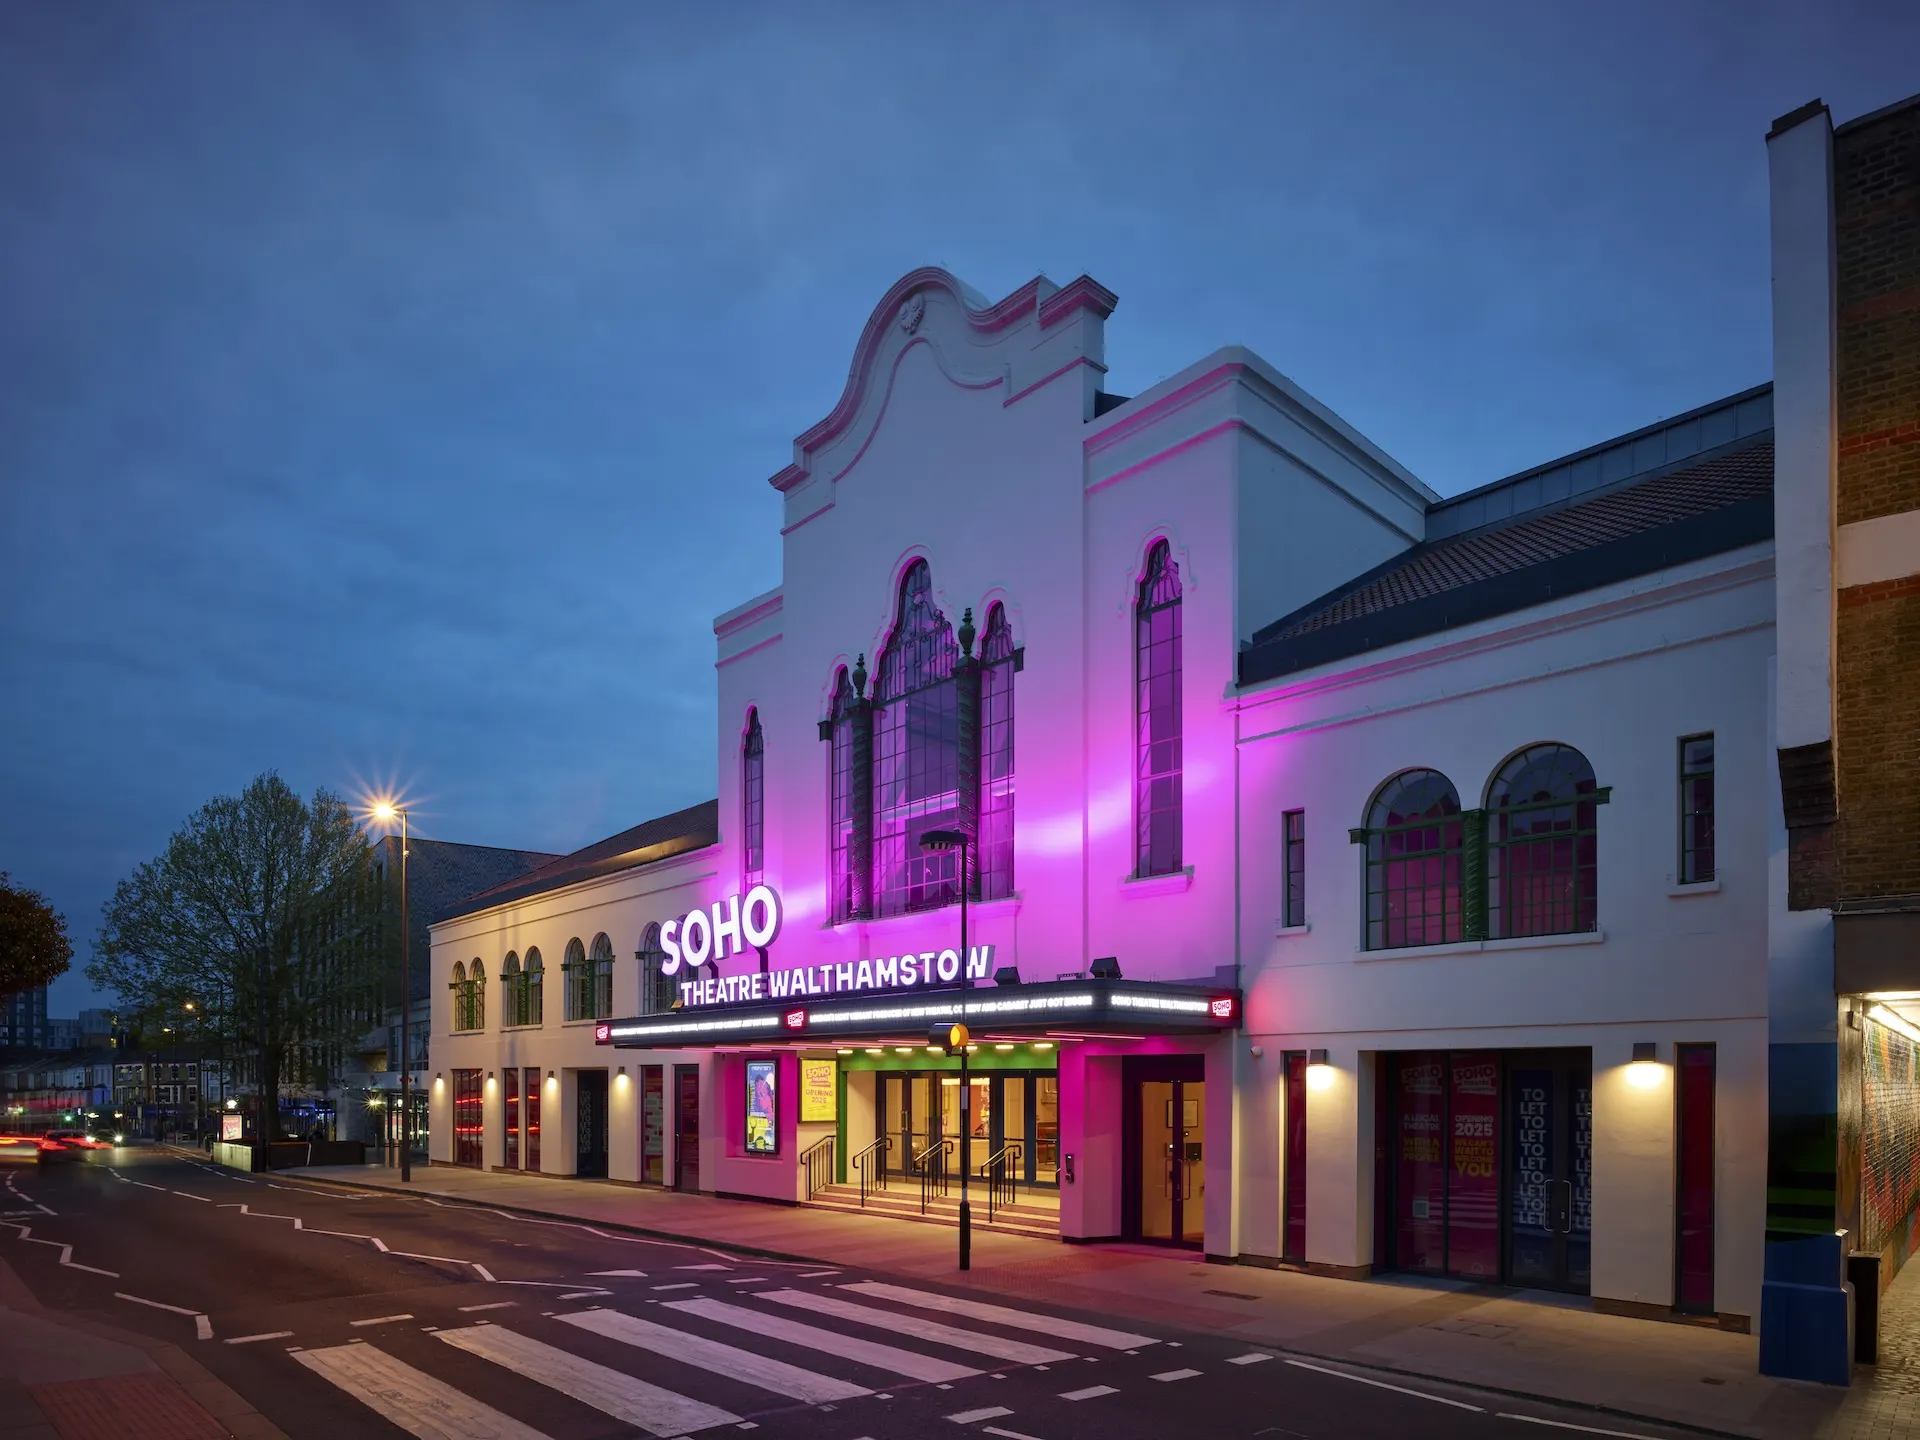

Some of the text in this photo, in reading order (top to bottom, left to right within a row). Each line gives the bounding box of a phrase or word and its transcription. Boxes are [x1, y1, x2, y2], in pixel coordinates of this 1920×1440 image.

[660, 885, 779, 975] SOHO
[681, 945, 991, 1006] THEATRE WALTHAMSTOW
[1029, 999, 1047, 1008] JUST
[1047, 998, 1063, 1007] GOT
[1112, 995, 1131, 1006] SOHO
[1132, 997, 1159, 1007] THEATRE
[1213, 1001, 1230, 1011] SOHO
[788, 1013, 803, 1023] SOHO
[807, 1067, 830, 1079] SOHO
[1403, 1066, 1440, 1081] SOHO
[1455, 1066, 1494, 1080] SOHO
[805, 1089, 833, 1097] OPENING
[1521, 1089, 1544, 1100] TO
[1577, 1090, 1592, 1100] T
[811, 1096, 826, 1104] 2025
[1520, 1102, 1546, 1115] LET
[1575, 1103, 1592, 1115] LE
[1454, 1115, 1494, 1123] OPENING
[1521, 1116, 1544, 1129] TO
[1577, 1117, 1592, 1130] T
[1403, 1122, 1441, 1130] THEATRE
[1454, 1123, 1494, 1137] 2025
[1520, 1130, 1546, 1143] LET
[1575, 1131, 1592, 1144] LE
[1482, 1148, 1494, 1156] TO
[1521, 1143, 1544, 1156] TO
[1577, 1145, 1592, 1158] T
[1455, 1162, 1493, 1178] YOU
[1520, 1157, 1546, 1170] LET
[1575, 1159, 1592, 1172] LE
[1521, 1171, 1544, 1184] TO
[1577, 1173, 1592, 1186] T
[1520, 1184, 1545, 1197] LET
[1575, 1187, 1592, 1200] LE
[1521, 1198, 1544, 1211] TO
[1577, 1202, 1592, 1214] T
[1520, 1212, 1545, 1225] LET
[1575, 1215, 1592, 1229] LE
